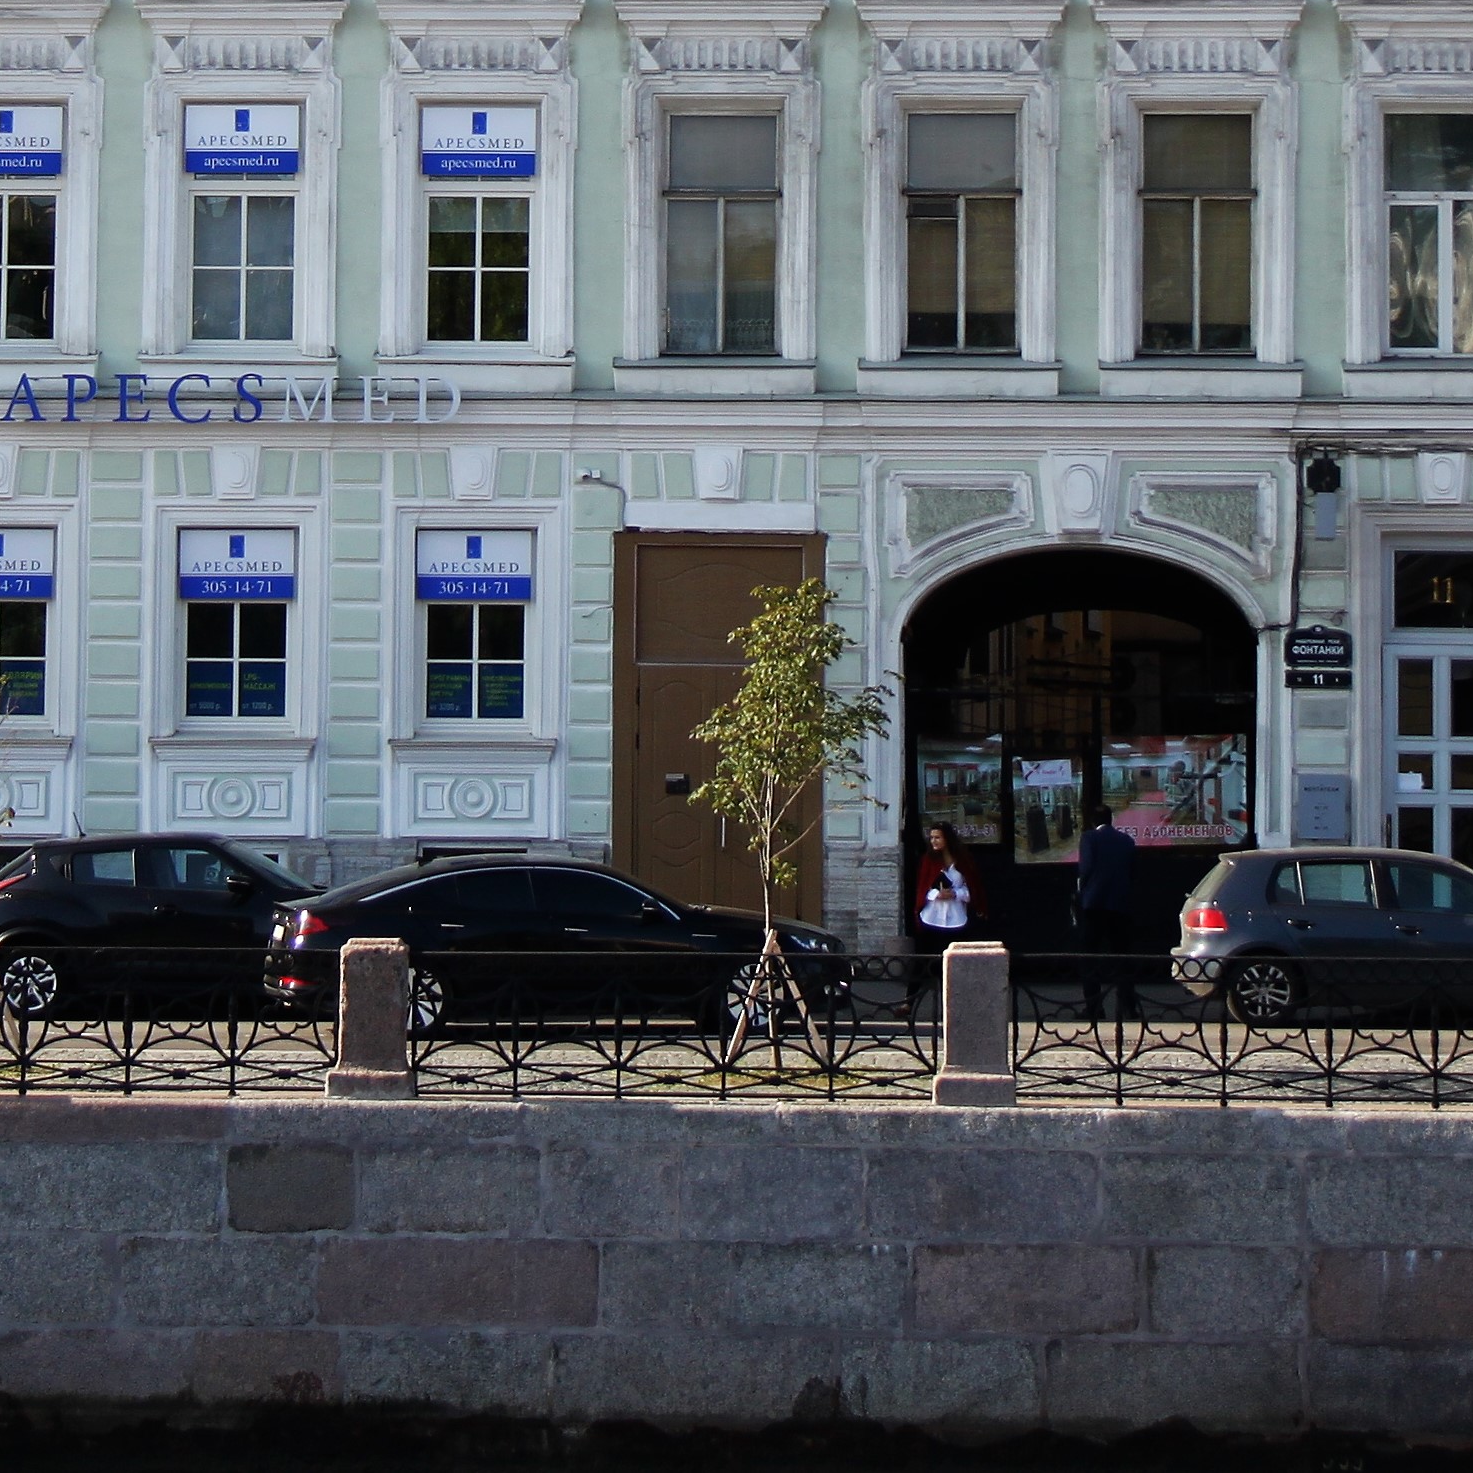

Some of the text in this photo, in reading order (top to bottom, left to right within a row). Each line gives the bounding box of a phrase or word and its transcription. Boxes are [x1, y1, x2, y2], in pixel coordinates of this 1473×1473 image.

[198, 135, 287, 146] APECSMED
[434, 138, 524, 149] APECSMED
[204, 155, 279, 169] apecsmed.ru
[441, 157, 516, 171] apecsmed.ru
[0, 372, 462, 424] APECSMED
[192, 561, 282, 572] APECSMED
[429, 562, 519, 573] APECSMED
[1292, 645, 1344, 655] ФОНТАНКИ
[1312, 674, 1324, 685] 11
[1143, 825, 1234, 839] АБОНЕМЕНТОВ
